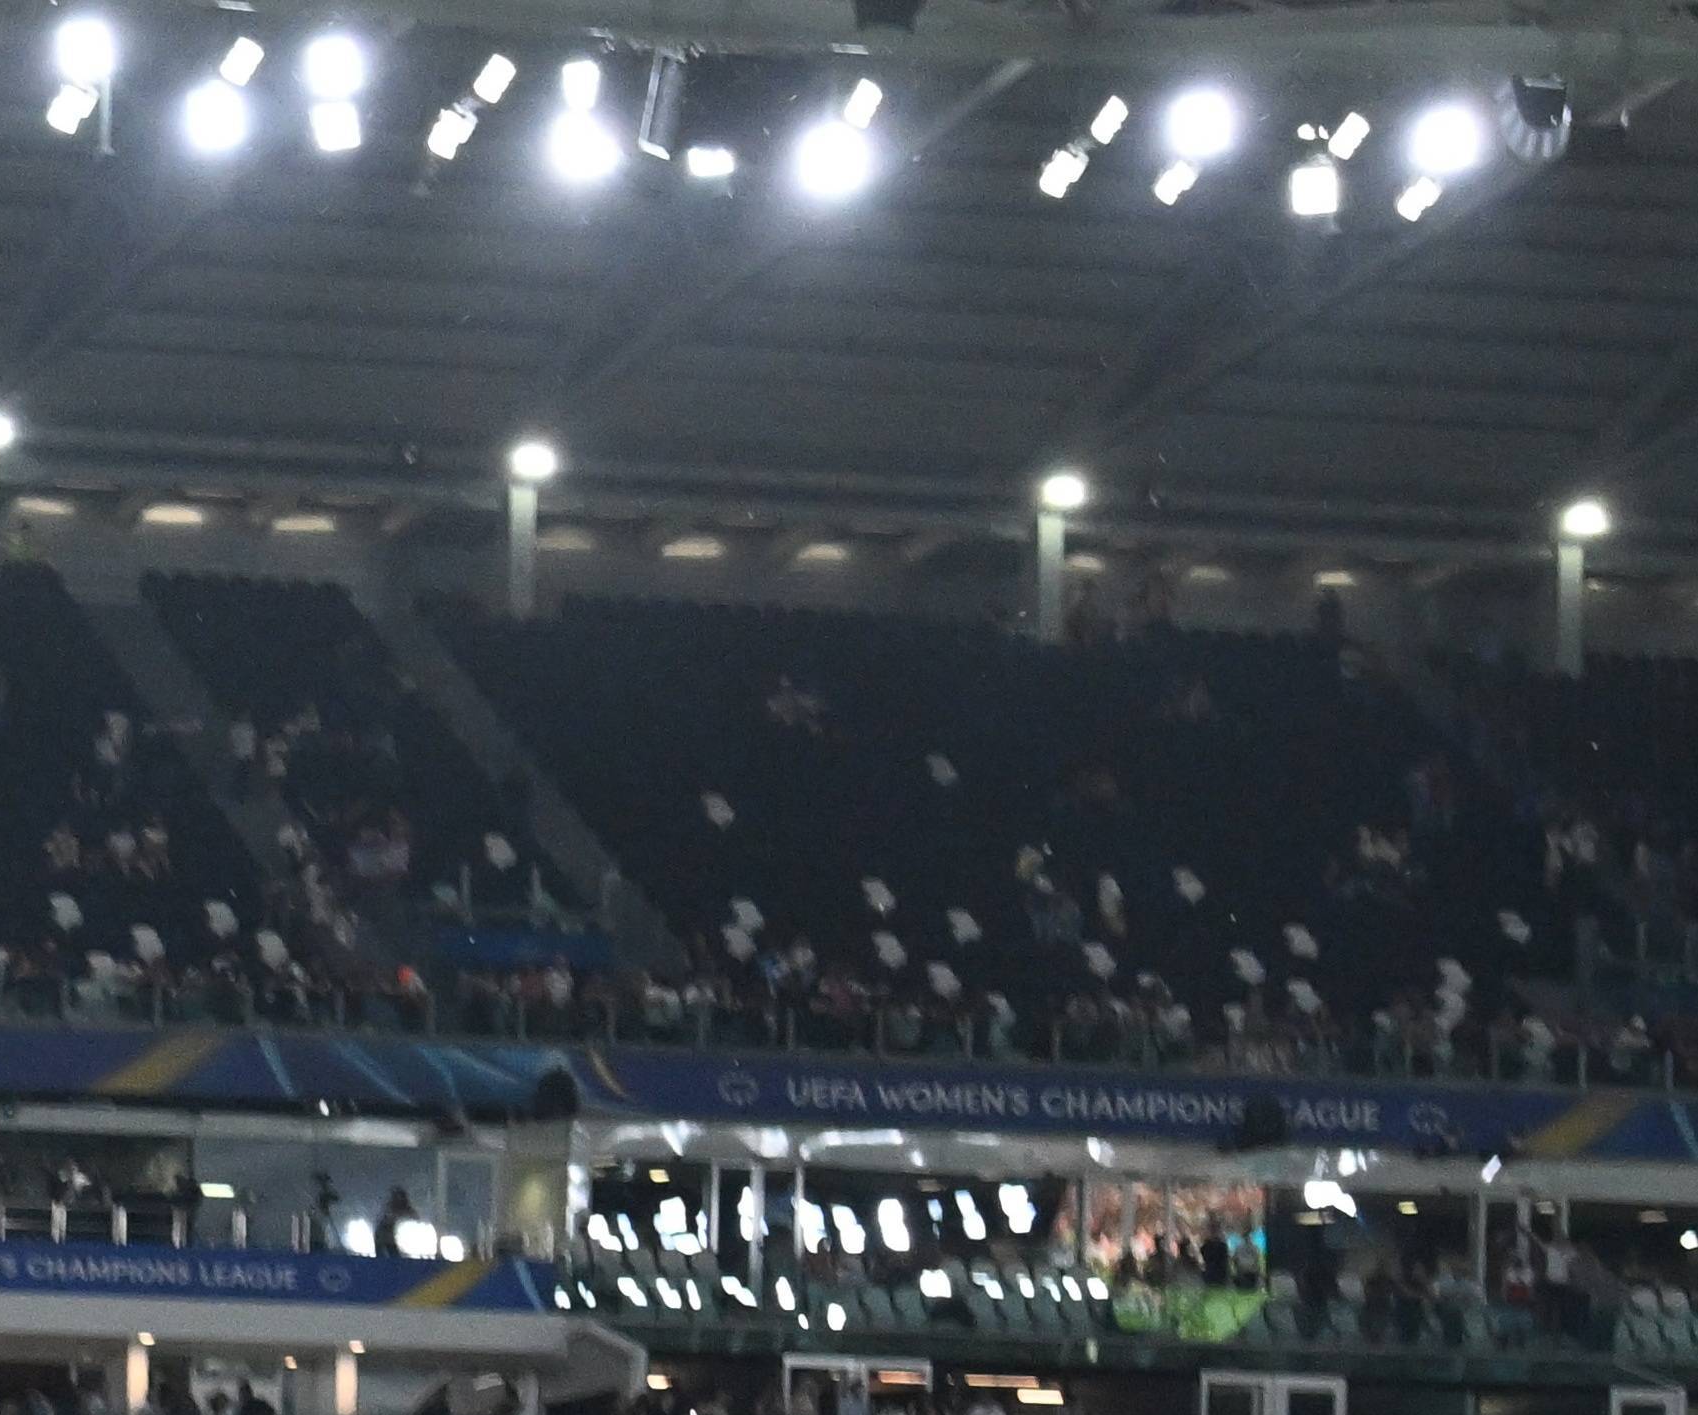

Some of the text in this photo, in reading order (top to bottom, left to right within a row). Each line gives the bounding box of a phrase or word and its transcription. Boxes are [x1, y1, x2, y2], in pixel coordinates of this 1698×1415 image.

[787, 1076, 1380, 1132] UEFA WOMEN'S CHAMPIONS AGUE
[26, 1255, 192, 1288] CHAMPIONS
[199, 1260, 298, 1290] LEAGUE
